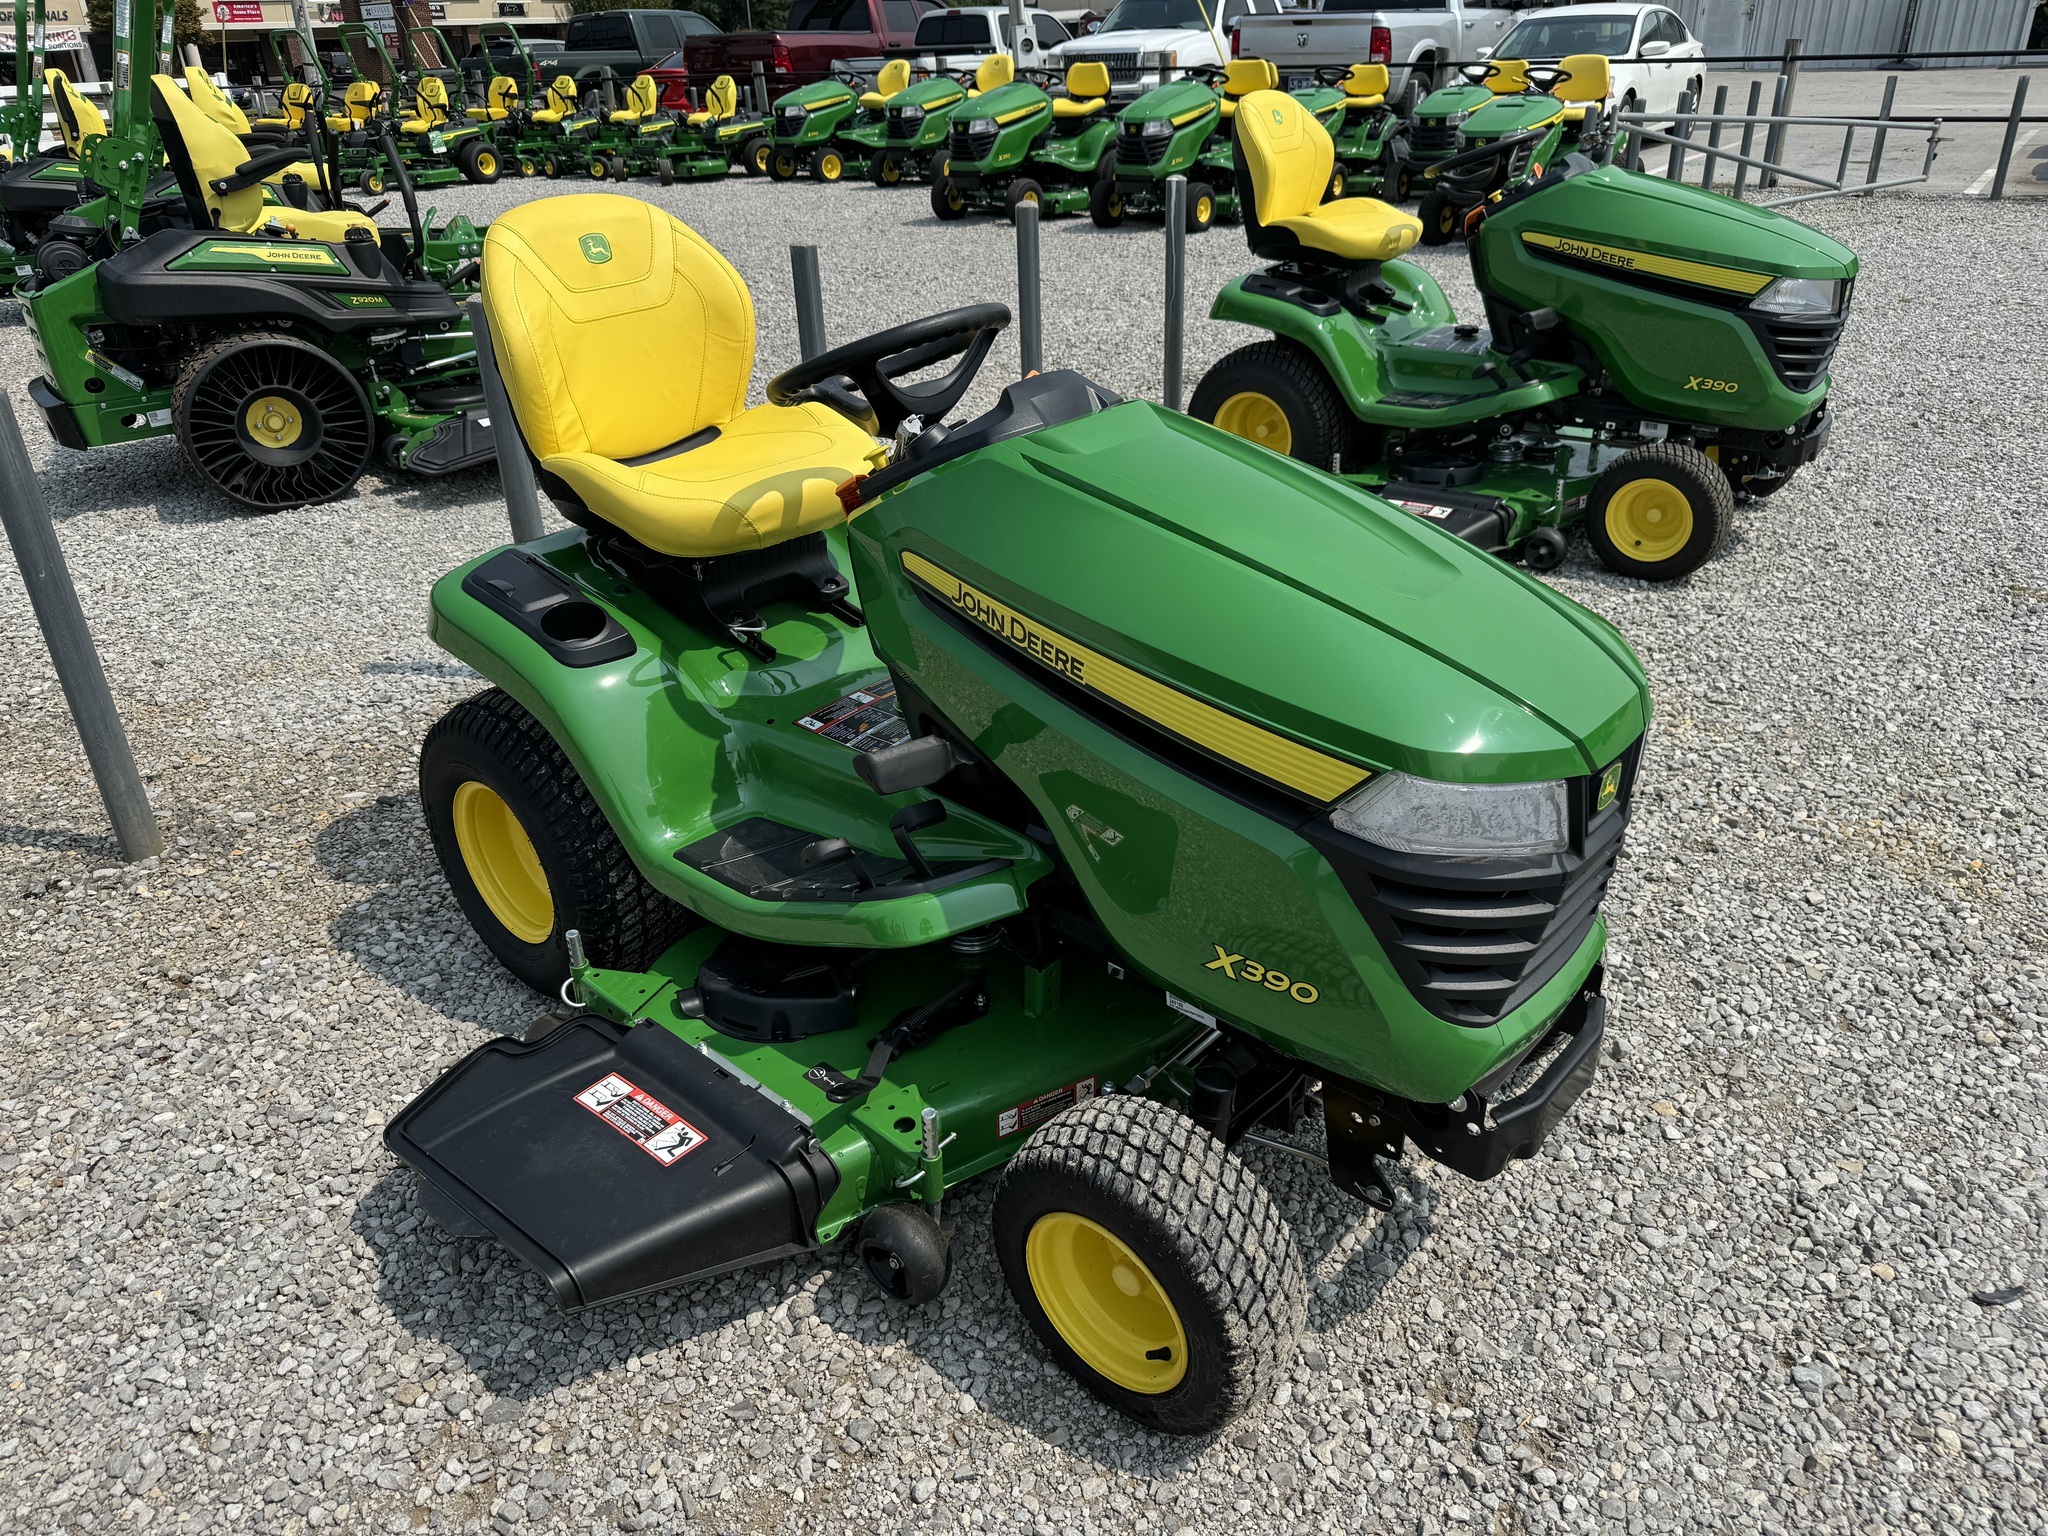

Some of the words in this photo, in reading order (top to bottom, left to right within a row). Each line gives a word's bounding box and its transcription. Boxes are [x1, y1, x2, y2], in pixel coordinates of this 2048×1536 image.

[266, 251, 291, 260] JOHN
[292, 252, 322, 260] DEERE
[1554, 238, 1589, 260] JOHN
[1591, 247, 1635, 269] DEERE
[350, 296, 383, 305] Z920M
[1682, 375, 1739, 394] X390
[951, 582, 1005, 633] JOHN
[1009, 616, 1085, 682] DEERE
[1202, 943, 1320, 1004] X390
[1038, 1088, 1063, 1102] DANGER
[643, 1096, 674, 1120] DANGER
